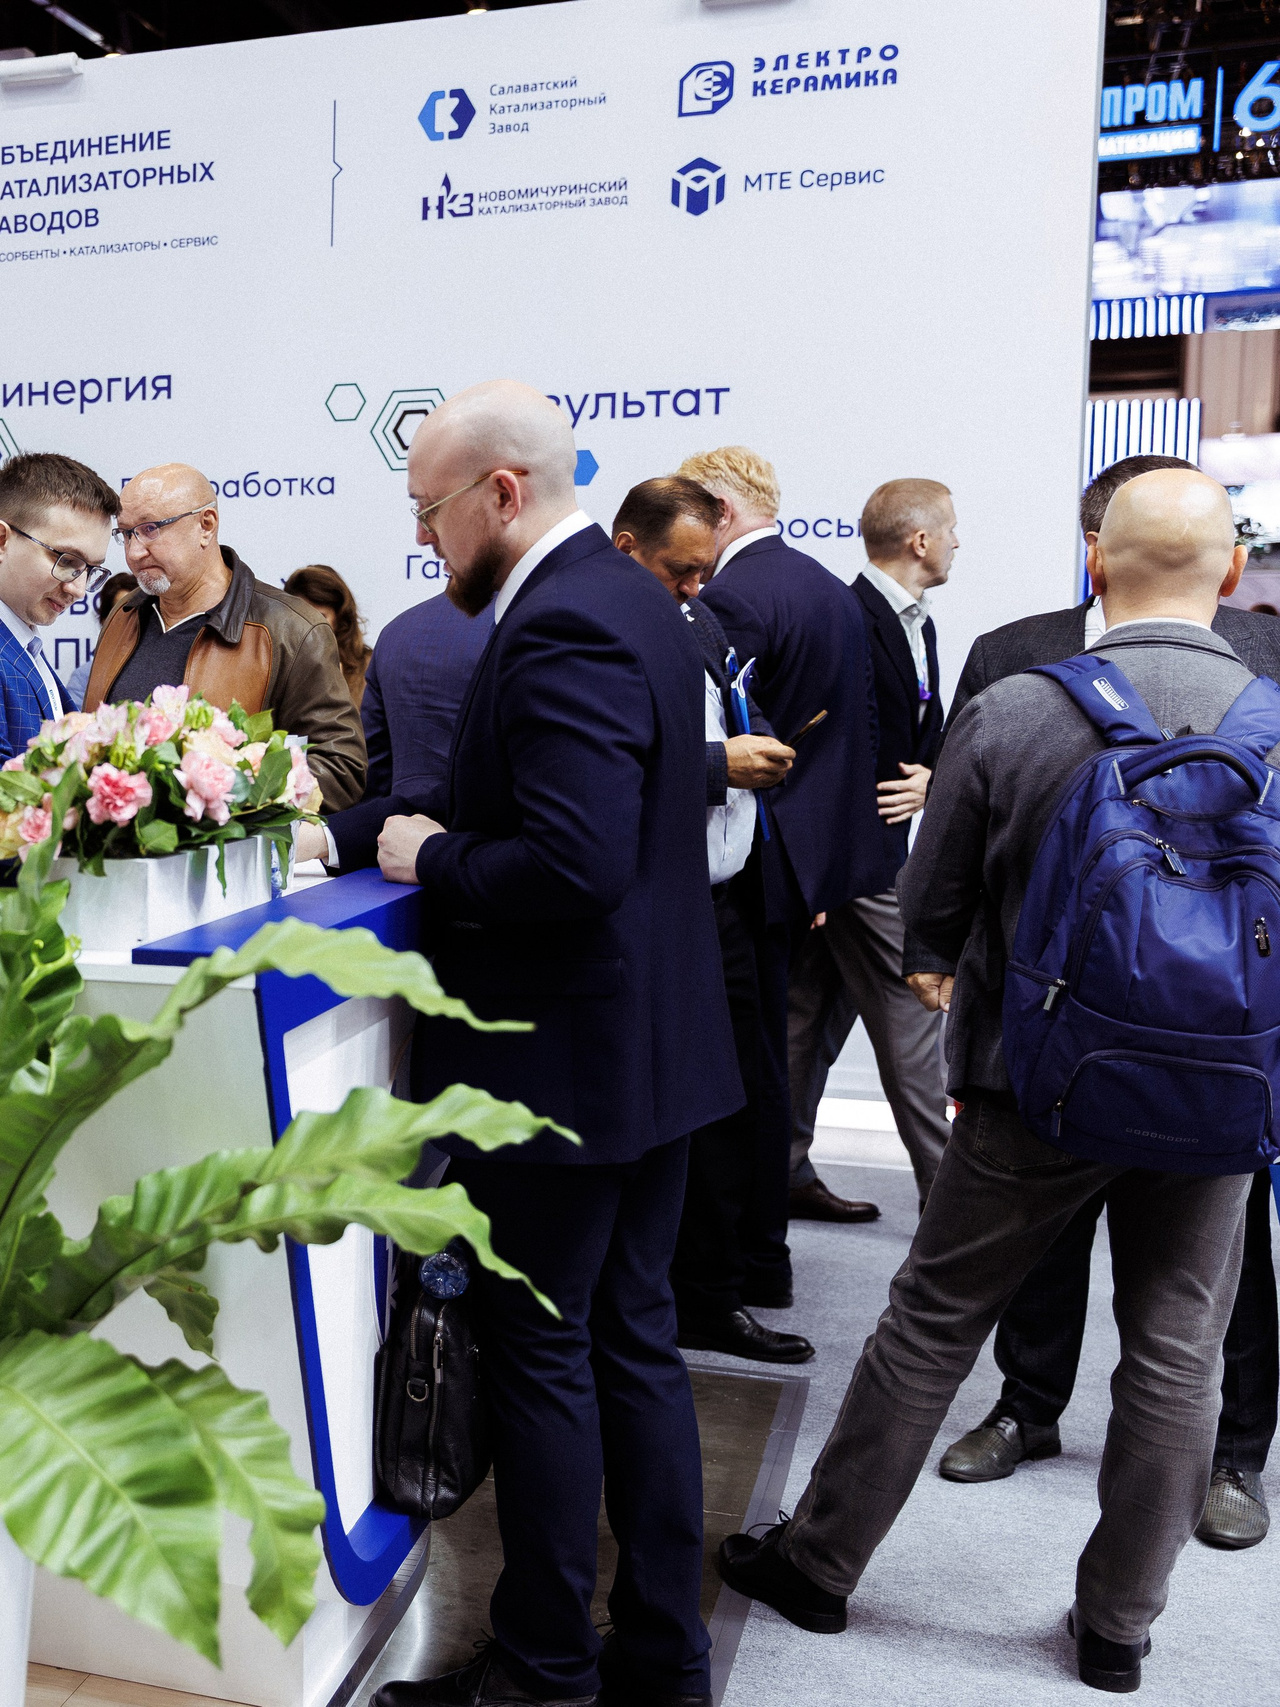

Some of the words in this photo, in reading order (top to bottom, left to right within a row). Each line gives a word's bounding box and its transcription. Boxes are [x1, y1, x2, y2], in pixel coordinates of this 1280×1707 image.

[753, 44, 899, 73] ЭЛЕКТРО
[489, 76, 578, 96] Салаватский
[752, 68, 898, 97] КЕРАМИКА
[489, 92, 607, 116] Катализаторный
[1100, 77, 1204, 128] ПРОМ
[488, 122, 530, 135] Завод
[478, 178, 628, 203] НОВОМИЧУРИНСКИЙ
[744, 171, 792, 192] МТЕ
[800, 169, 885, 192] Сервис
[478, 197, 586, 216] КАТАЛИЗАТОРНЫЙ
[590, 195, 628, 207] ЗАВОД
[69, 240, 161, 257] КАТАЛИЗАТОРЫ
[170, 235, 219, 249] СЕРВИС
